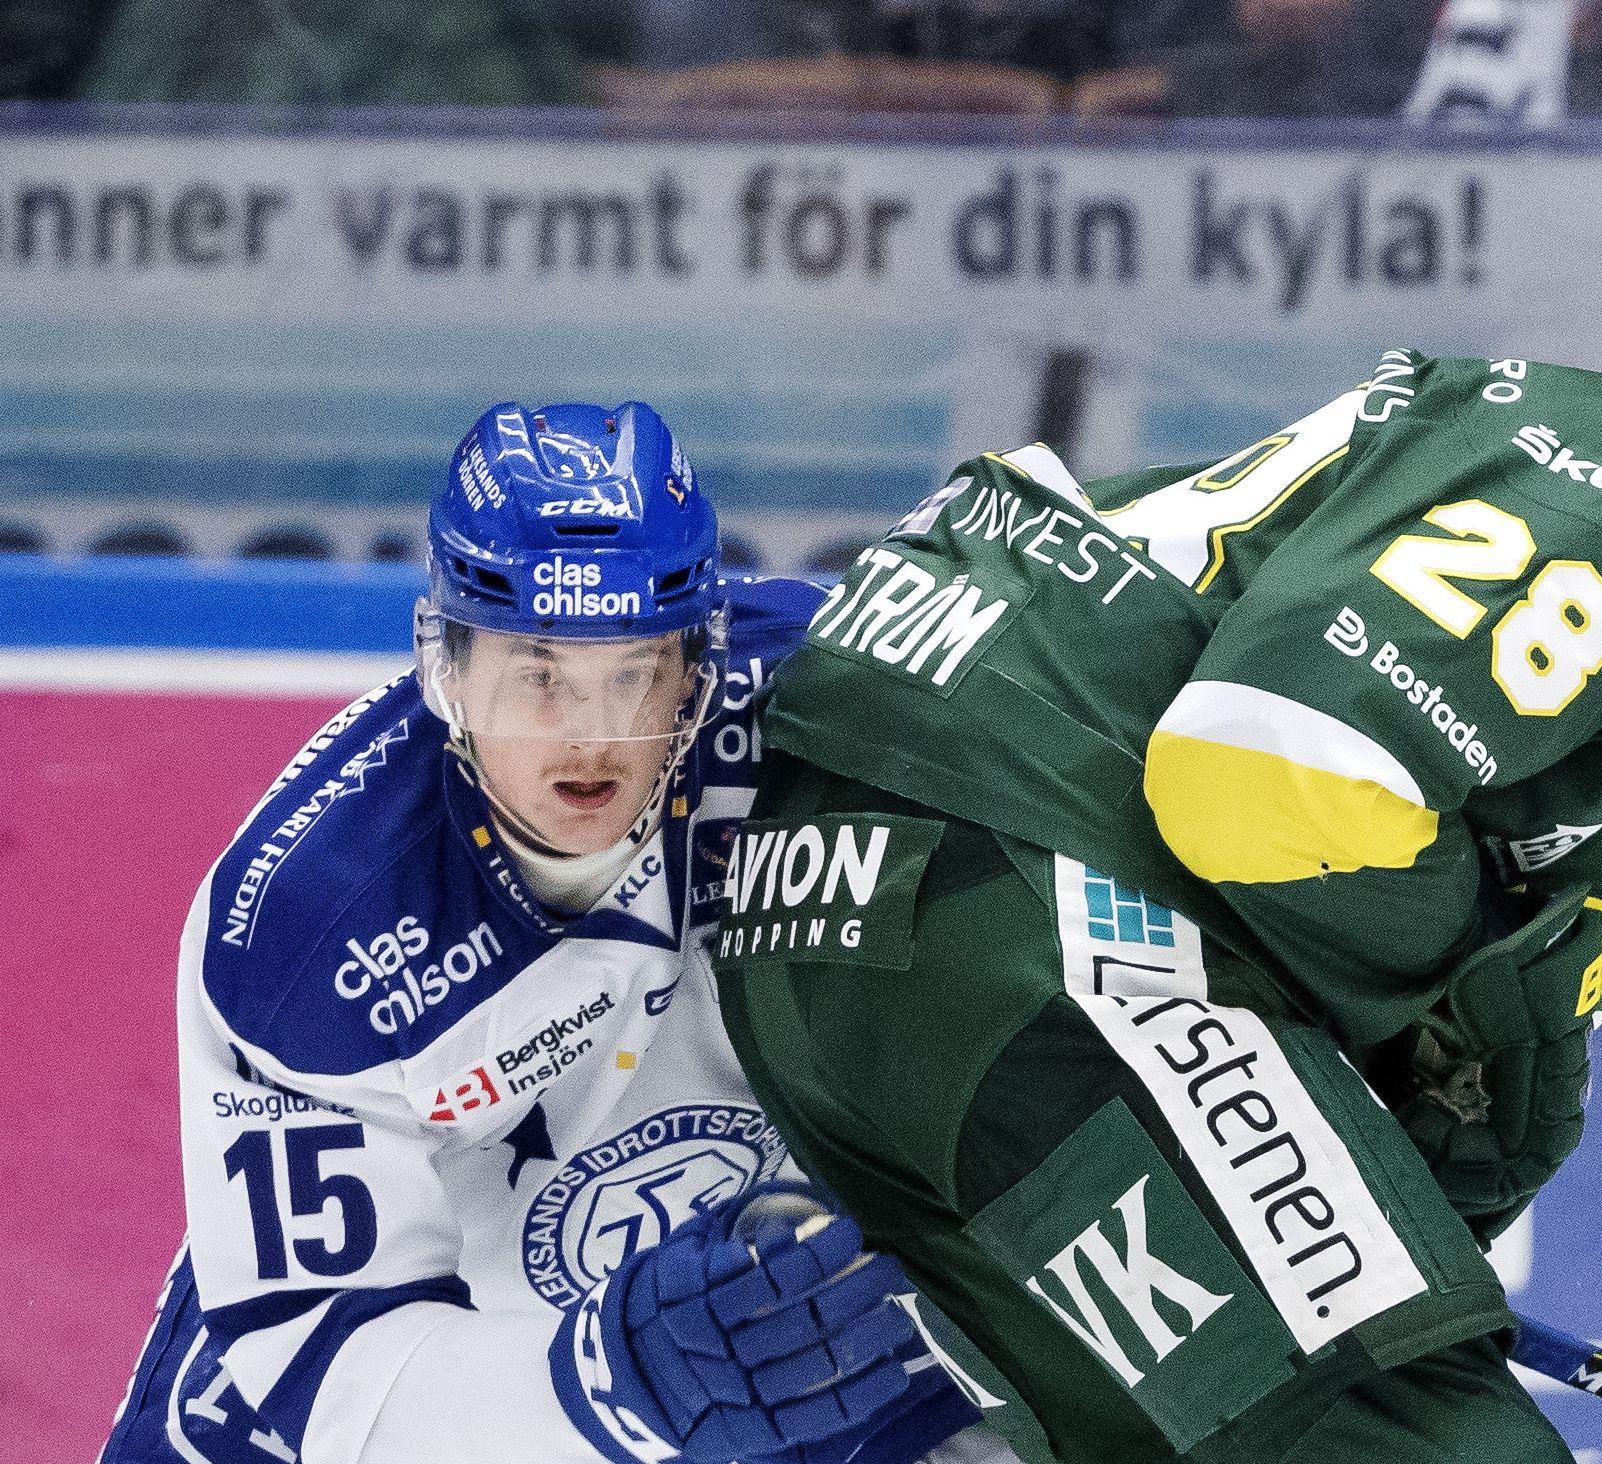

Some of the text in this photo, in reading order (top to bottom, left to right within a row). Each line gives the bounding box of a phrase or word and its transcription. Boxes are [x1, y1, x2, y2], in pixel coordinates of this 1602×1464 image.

[0, 160, 1486, 311] nner varmt för din kyla!
[540, 499, 634, 519] CCM
[952, 487, 1157, 605] INVEST
[534, 556, 601, 587] clas
[534, 585, 640, 616] ohlson
[1372, 640, 1500, 786] Bostaden
[272, 779, 344, 841] KARL
[221, 842, 284, 947] HEDIN
[613, 854, 663, 908] KLC
[335, 915, 429, 999] clas
[720, 919, 862, 958] HOPPING
[497, 991, 617, 1075] Bergkvist
[508, 1037, 594, 1096] Insjön
[223, 1122, 378, 1280] 15
[527, 1164, 587, 1308] LEKSANDS
[1025, 1173, 1235, 1390] VK
